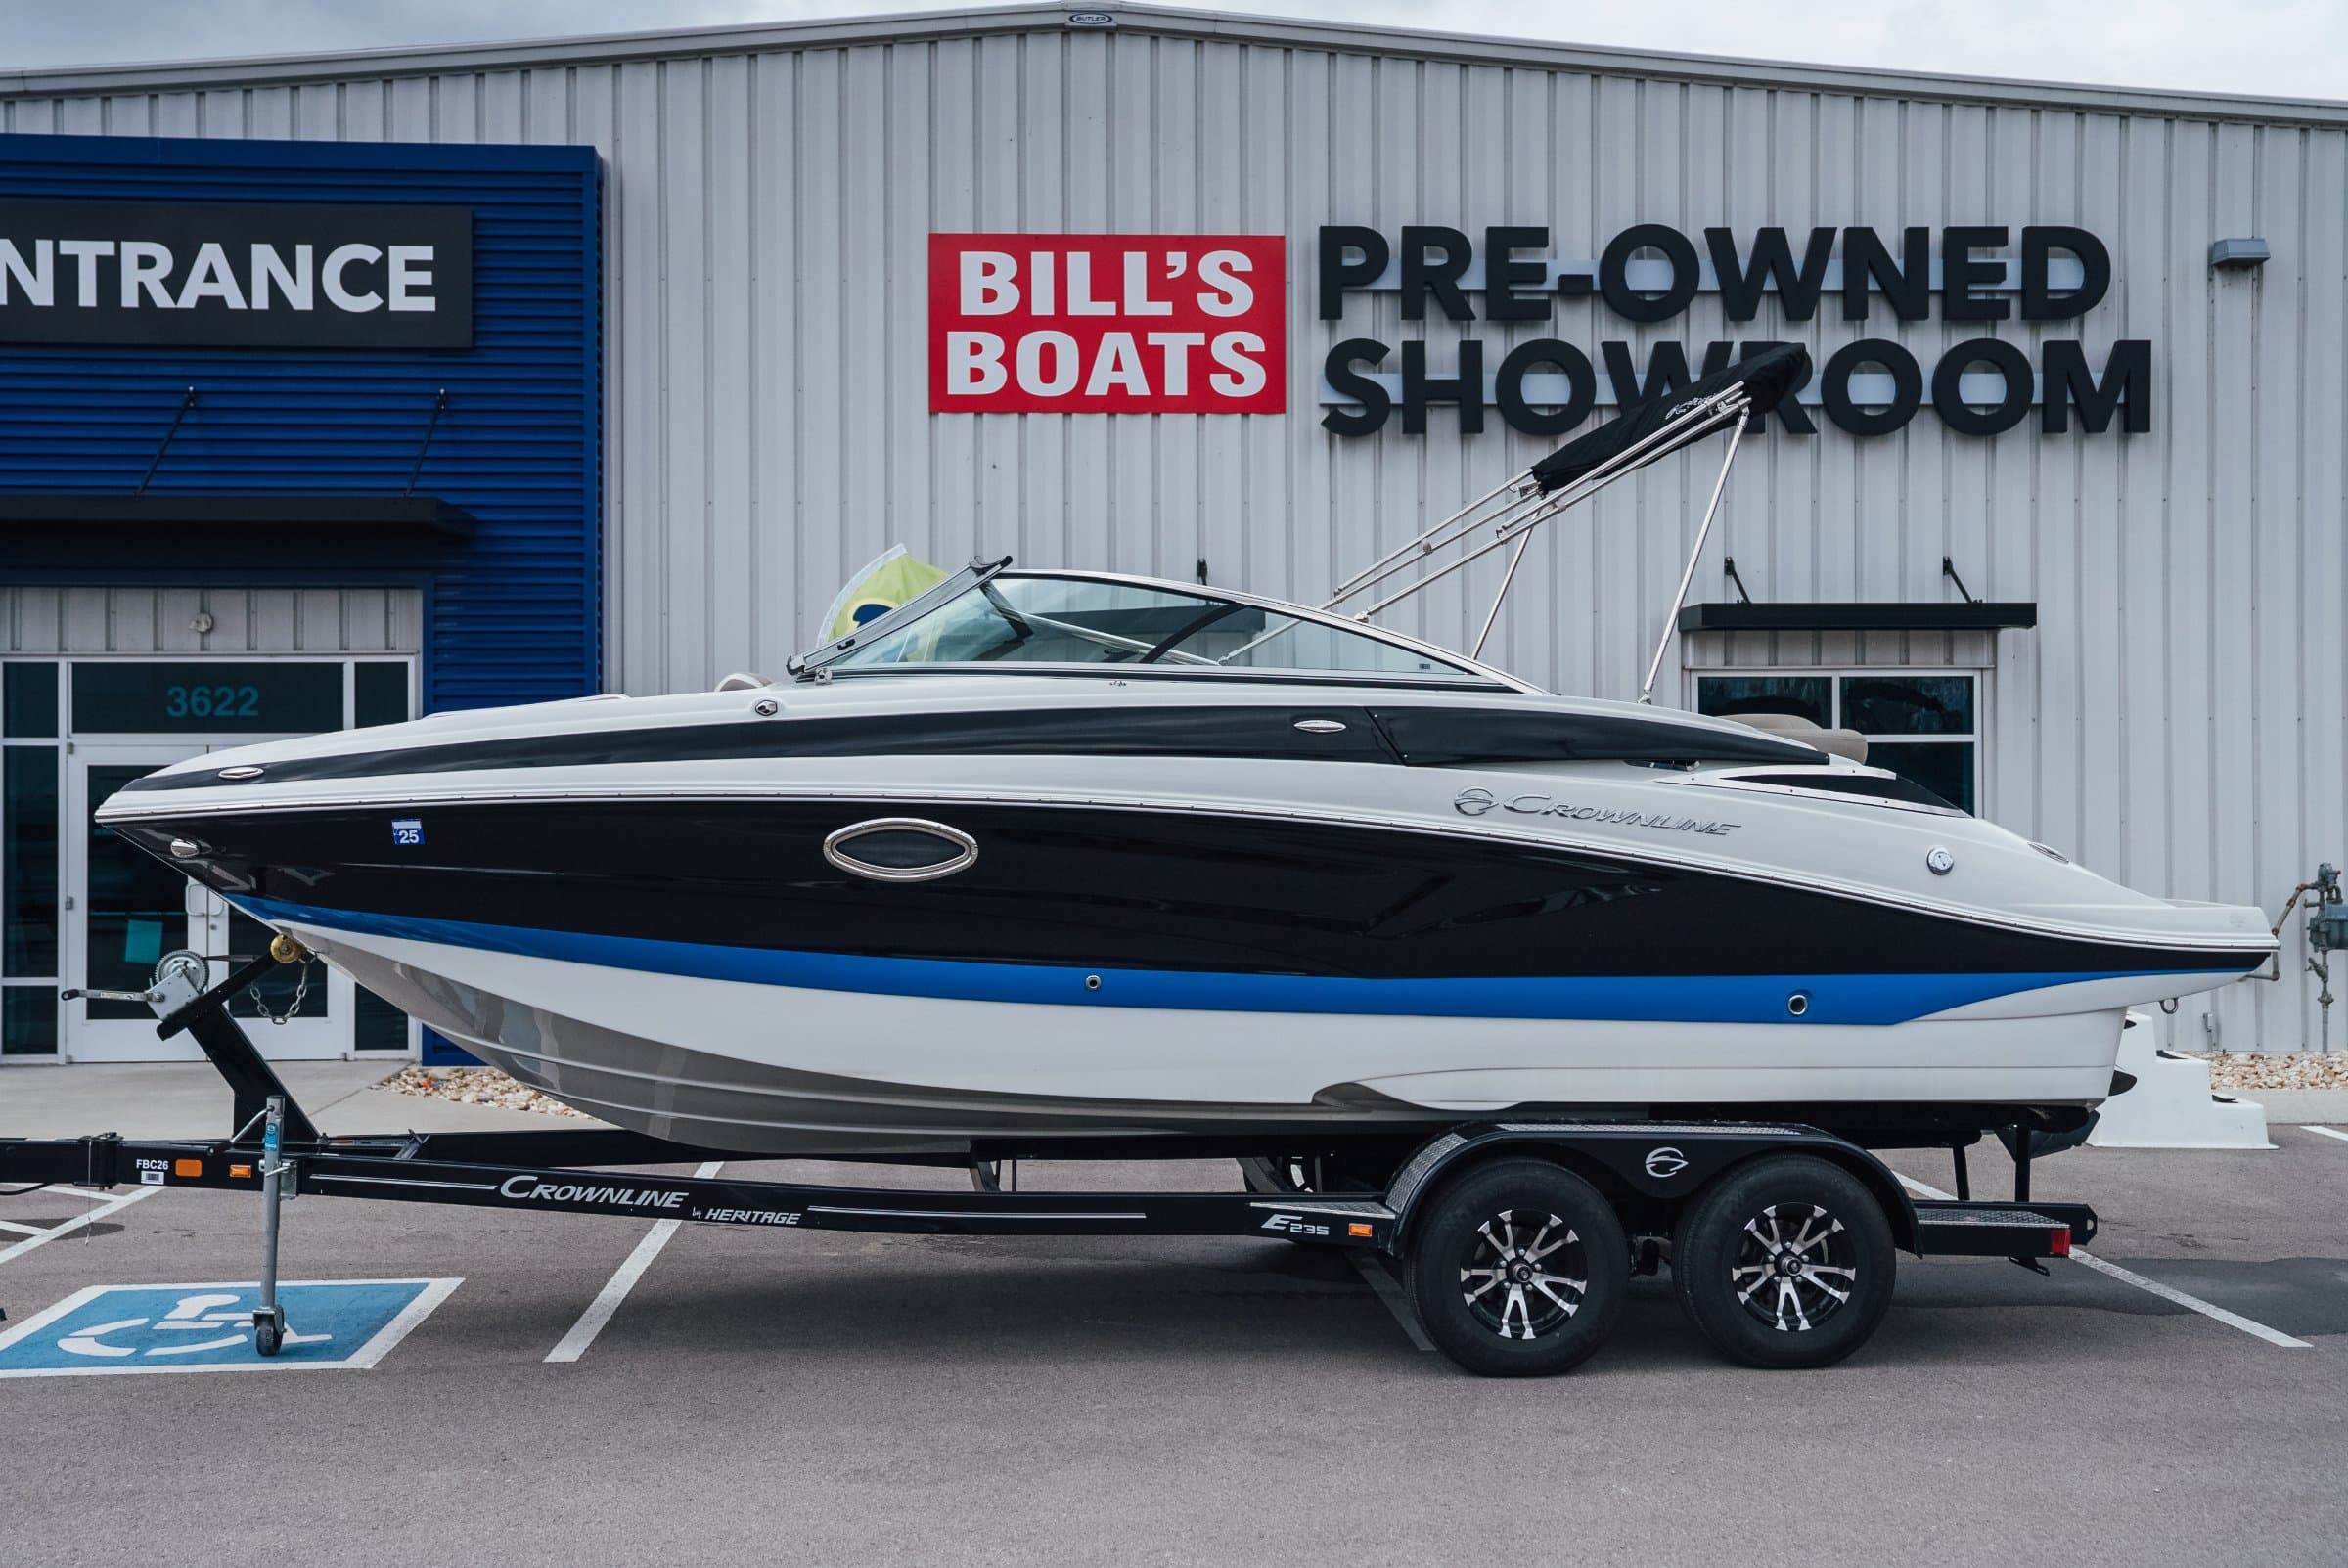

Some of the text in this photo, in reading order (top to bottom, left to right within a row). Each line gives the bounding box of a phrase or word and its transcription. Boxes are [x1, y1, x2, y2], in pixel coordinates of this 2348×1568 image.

[960, 249, 1254, 317] BILL'S
[1319, 223, 2111, 323] PRE-OWNED
[946, 330, 1267, 397] BOATS
[166, 686, 259, 717] 3622
[398, 829, 420, 844] 25
[1503, 794, 1742, 836] CROWNLINE
[136, 1159, 169, 1171] FBC26
[500, 1175, 802, 1225] CROWNLINE by HERITAGE
